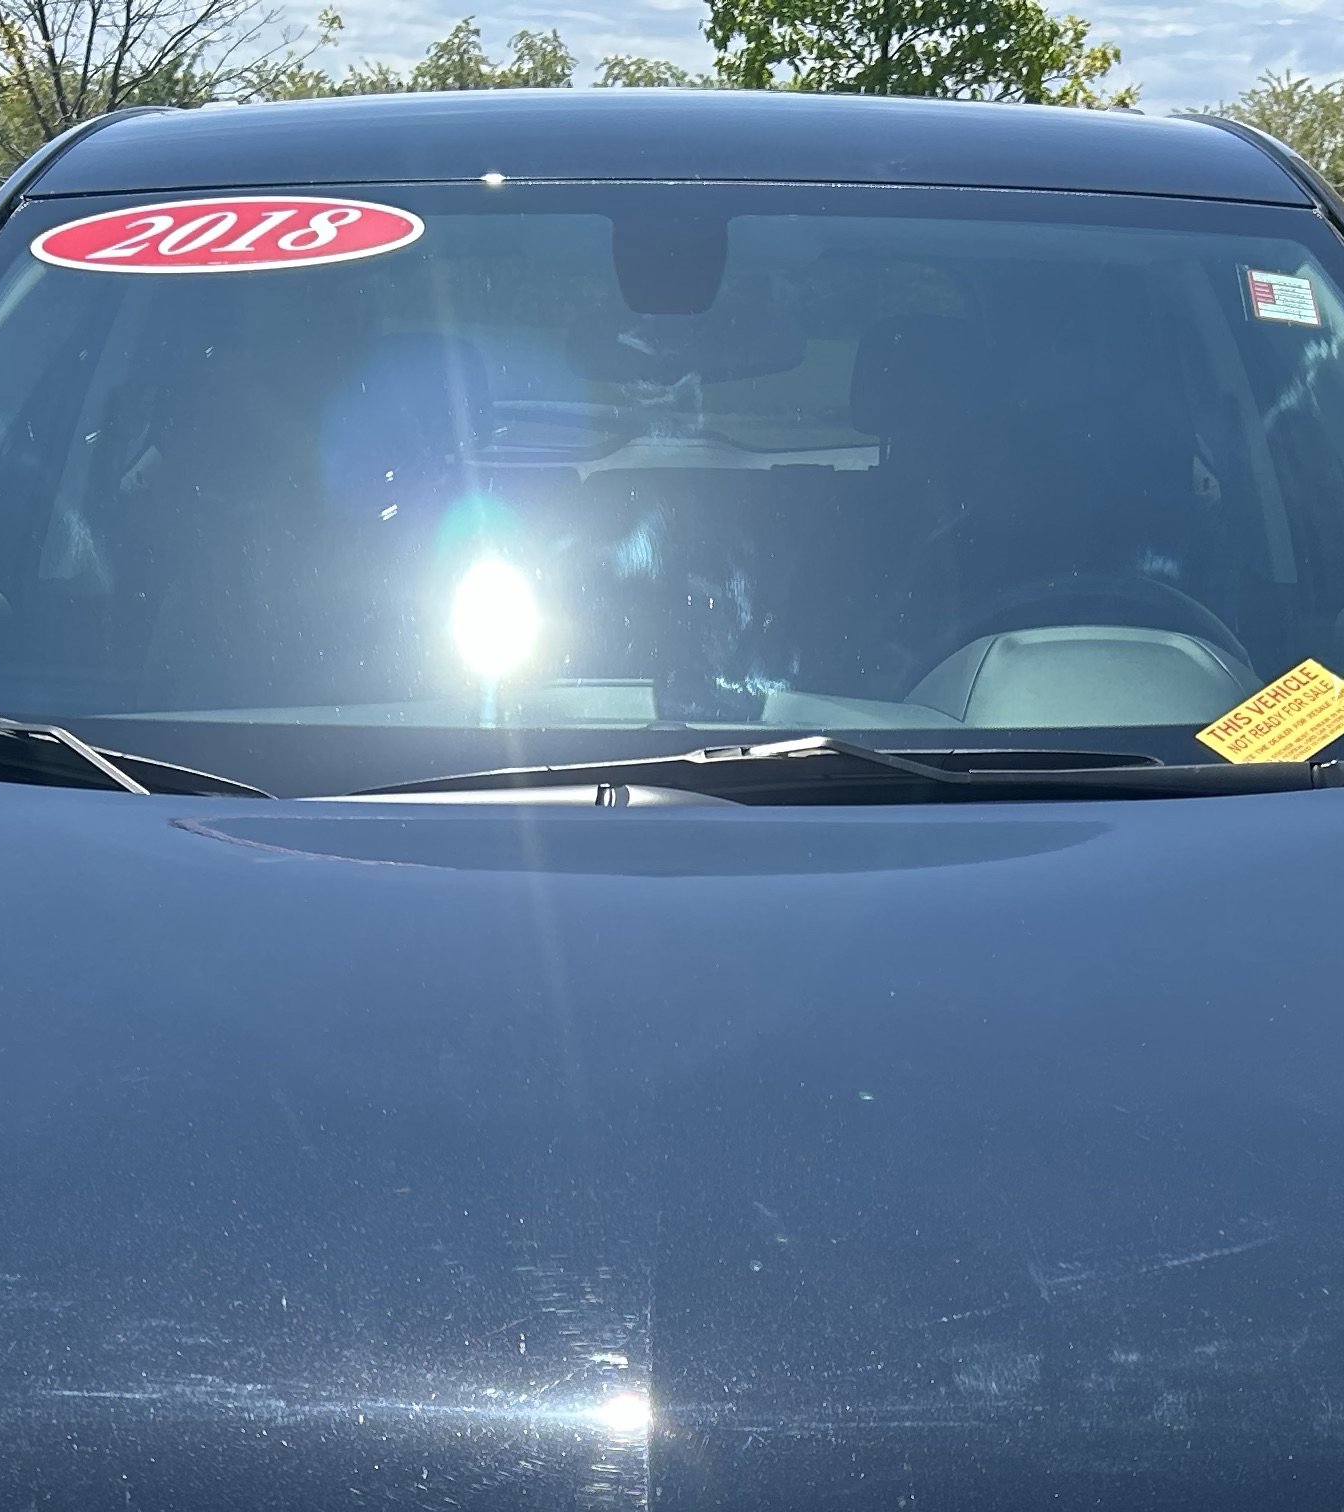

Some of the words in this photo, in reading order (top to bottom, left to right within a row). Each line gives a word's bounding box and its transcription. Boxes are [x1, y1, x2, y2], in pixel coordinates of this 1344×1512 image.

[85, 207, 362, 260] 2018
[1206, 711, 1253, 743] THIS
[1245, 666, 1319, 716] VEHICLE
[1226, 734, 1255, 754] NOT
[1248, 711, 1287, 739] READY
[1281, 697, 1309, 716] FOR
[1302, 679, 1334, 702] SALE
